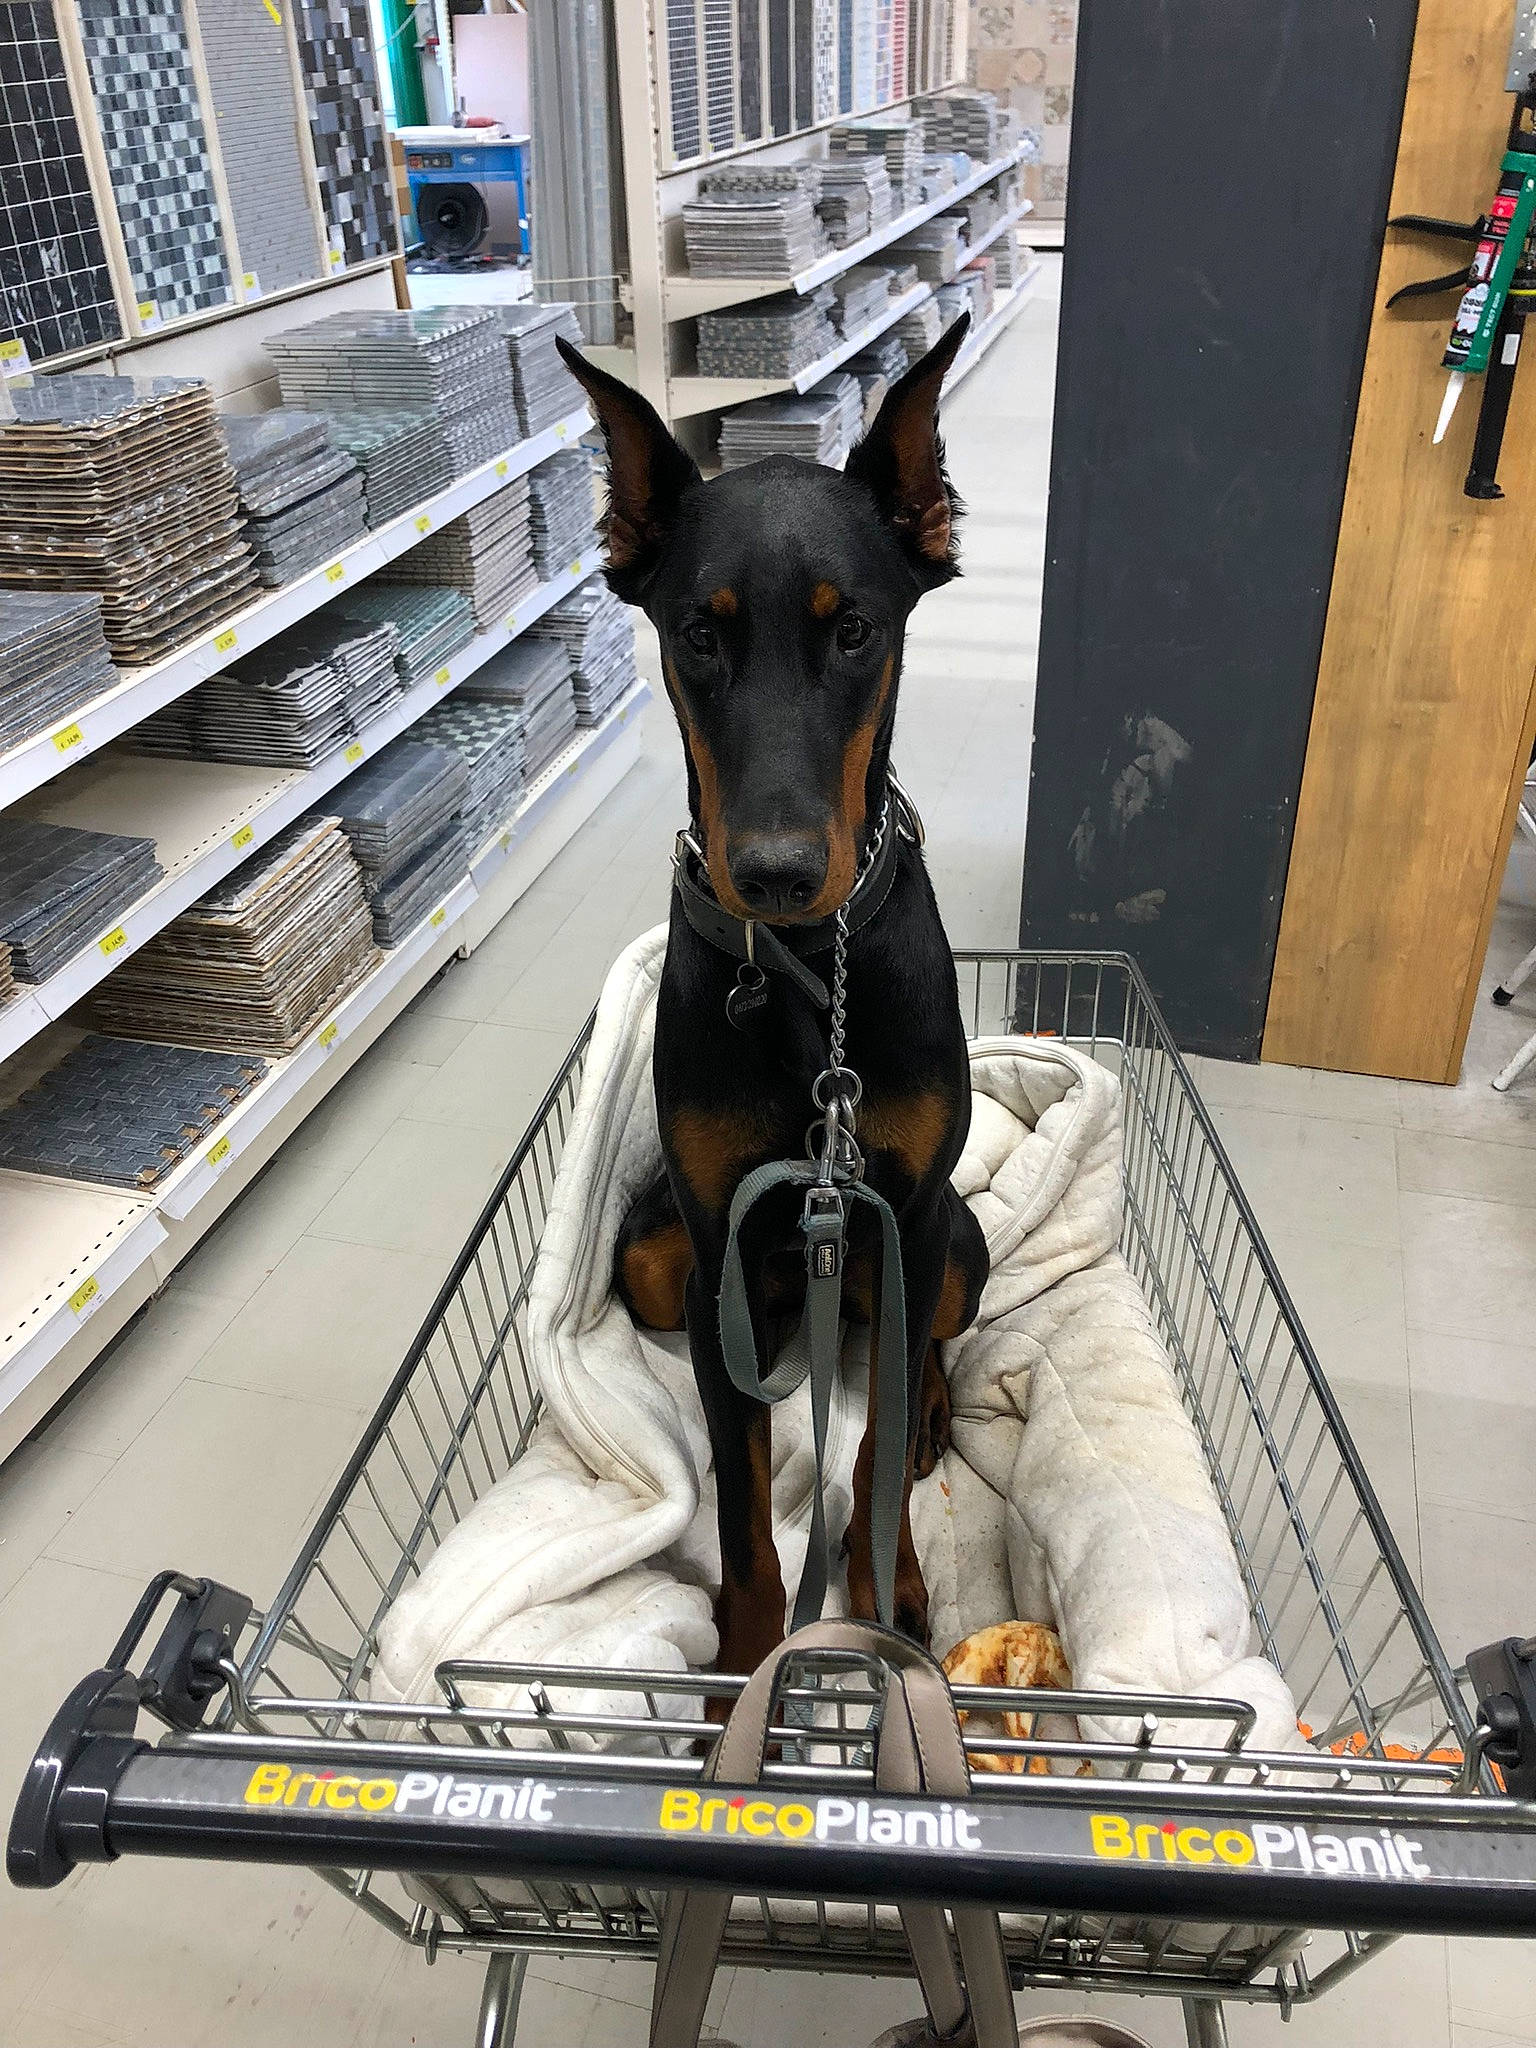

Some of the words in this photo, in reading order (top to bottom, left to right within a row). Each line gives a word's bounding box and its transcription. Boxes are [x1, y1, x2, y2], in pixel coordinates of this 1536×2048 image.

[244, 1763, 557, 1822] BricoPlanit
[659, 1788, 983, 1850] BricoPlanit
[1090, 1814, 1431, 1879] BricoPlanit
